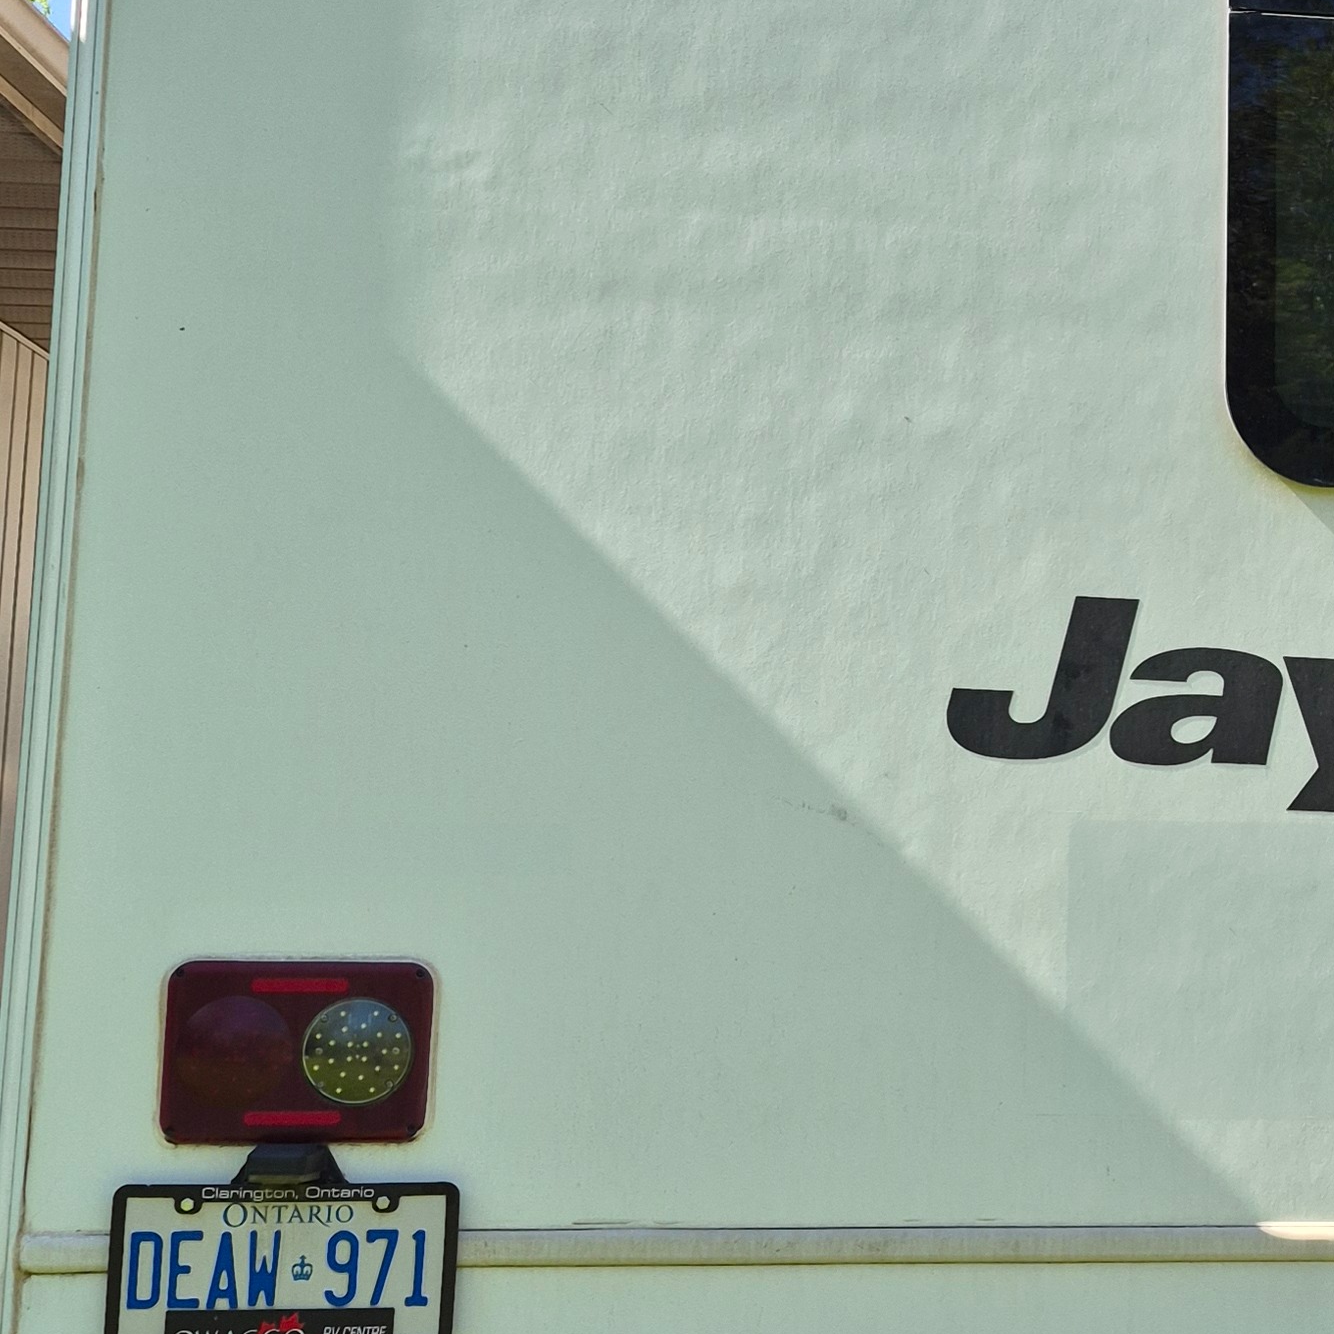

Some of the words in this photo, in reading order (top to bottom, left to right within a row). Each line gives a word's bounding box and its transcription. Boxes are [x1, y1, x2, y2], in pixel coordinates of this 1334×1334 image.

[201, 1186, 299, 1202] Clarington,
[305, 1186, 375, 1199] Ontario
[222, 1202, 354, 1228] ONTARIO
[126, 1229, 282, 1310] DEAW
[323, 1228, 429, 1308] 971
